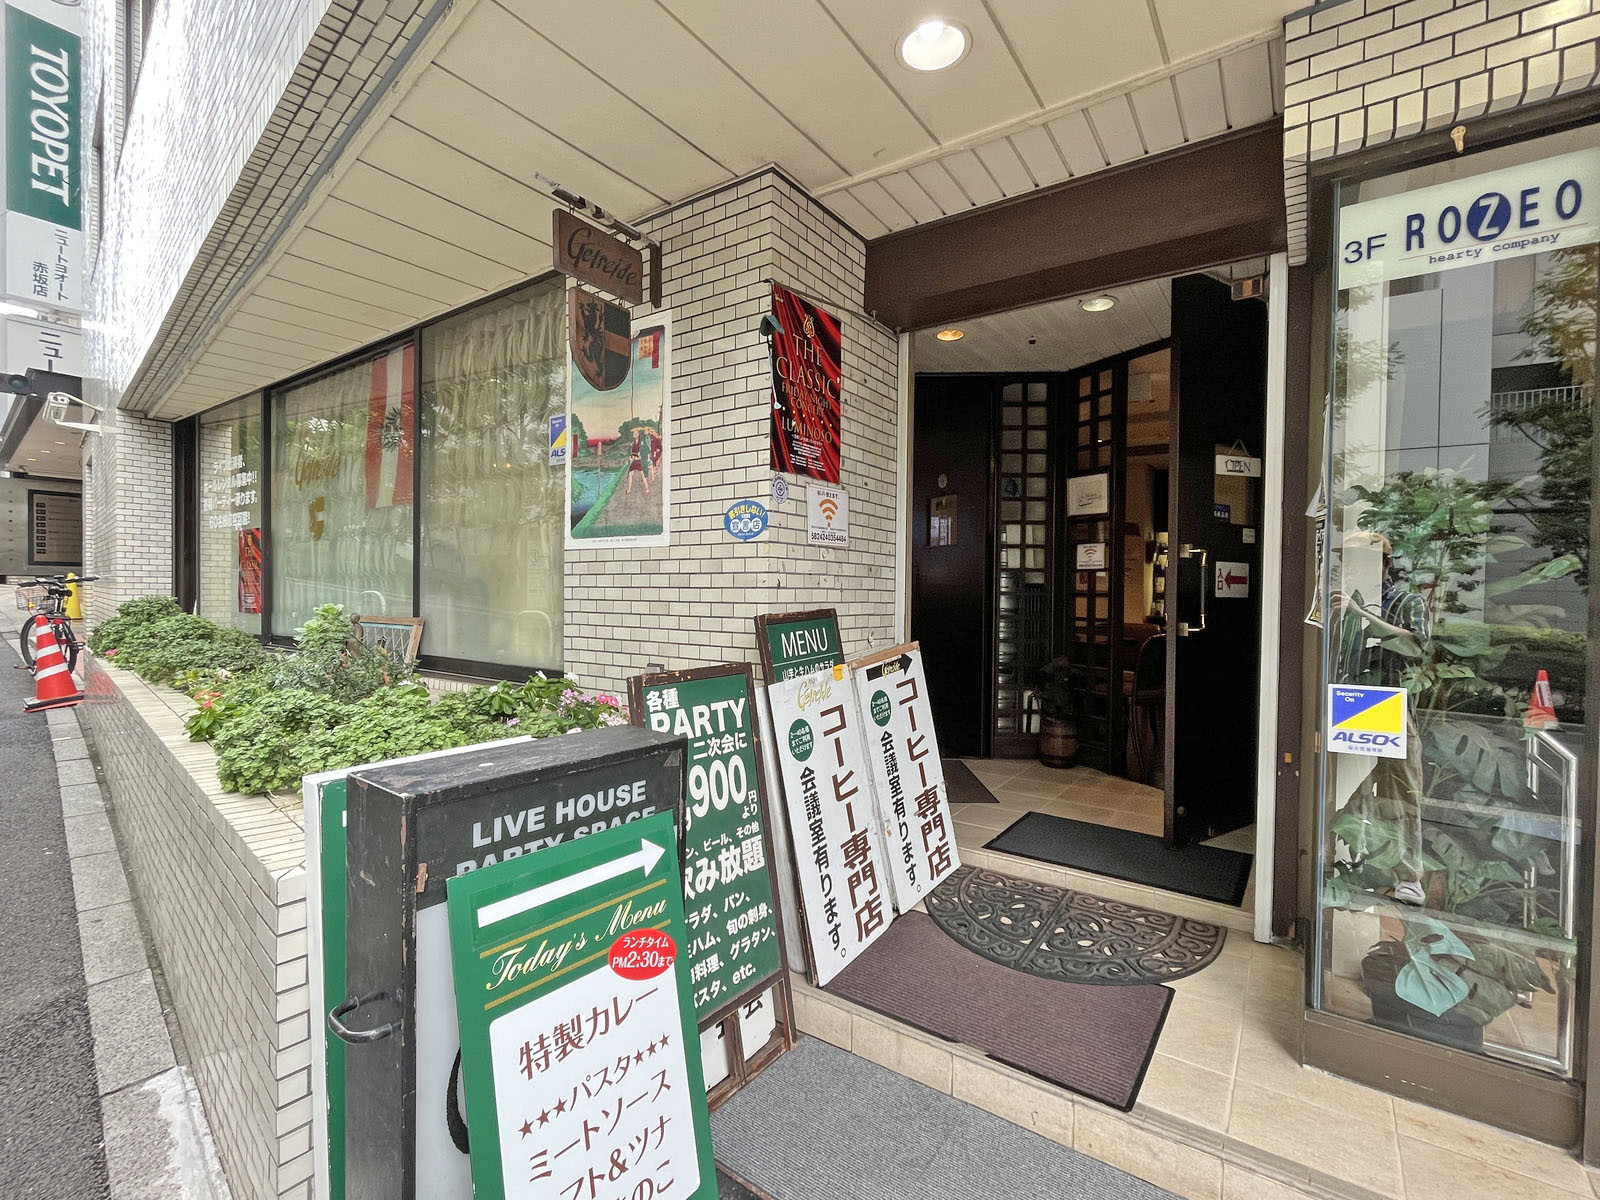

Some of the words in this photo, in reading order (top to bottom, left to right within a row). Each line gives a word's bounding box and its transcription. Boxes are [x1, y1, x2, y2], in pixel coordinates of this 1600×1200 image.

[30, 44, 70, 208] TOYOPET
[54, 228, 70, 301] ニュートヨオート
[567, 226, 638, 286] Getreide
[1344, 233, 1388, 264] 3F
[1429, 247, 1483, 265] hearty
[1492, 231, 1561, 253] company
[32, 260, 49, 298] 赤坂店
[792, 333, 823, 367] THE
[776, 356, 838, 399] CLASSIC
[782, 416, 833, 444] LUMINOSO
[1224, 459, 1251, 473] OPEN
[1217, 568, 1224, 591] 入口
[781, 627, 828, 659] MENU
[646, 687, 679, 712] 各種
[1336, 690, 1365, 698] Security
[650, 697, 746, 739] PARTY
[693, 732, 747, 760] 二次会に
[1332, 731, 1401, 748] ALSOK
[748, 789, 757, 804] 円
[895, 678, 952, 881] コーヒー専門店
[472, 805, 546, 848] LIVE
[555, 779, 647, 825] HOUSE
[742, 803, 758, 819] より
[820, 703, 883, 943] コーヒー専門店
[880, 730, 922, 893] 会議室有ります。
[703, 833, 732, 852] ビール、
[736, 820, 759, 838] その他
[799, 766, 847, 958] 会議室有ります。
[685, 903, 718, 930] ラダ、
[724, 891, 750, 912] パン、
[486, 931, 589, 991] Today's
[594, 899, 668, 942] Menu
[622, 936, 669, 949] ランチタイム
[688, 931, 721, 958] ハム、
[726, 902, 773, 935] 旬の刺身、
[612, 949, 674, 969] PM2:30まで
[690, 953, 724, 984] 料理、
[730, 927, 776, 960] グラタン、
[732, 963, 757, 985] etc.
[519, 987, 659, 1081] 特製カレー
[529, 1069, 672, 1183] ミートソース
[617, 1159, 675, 1200] のこ
